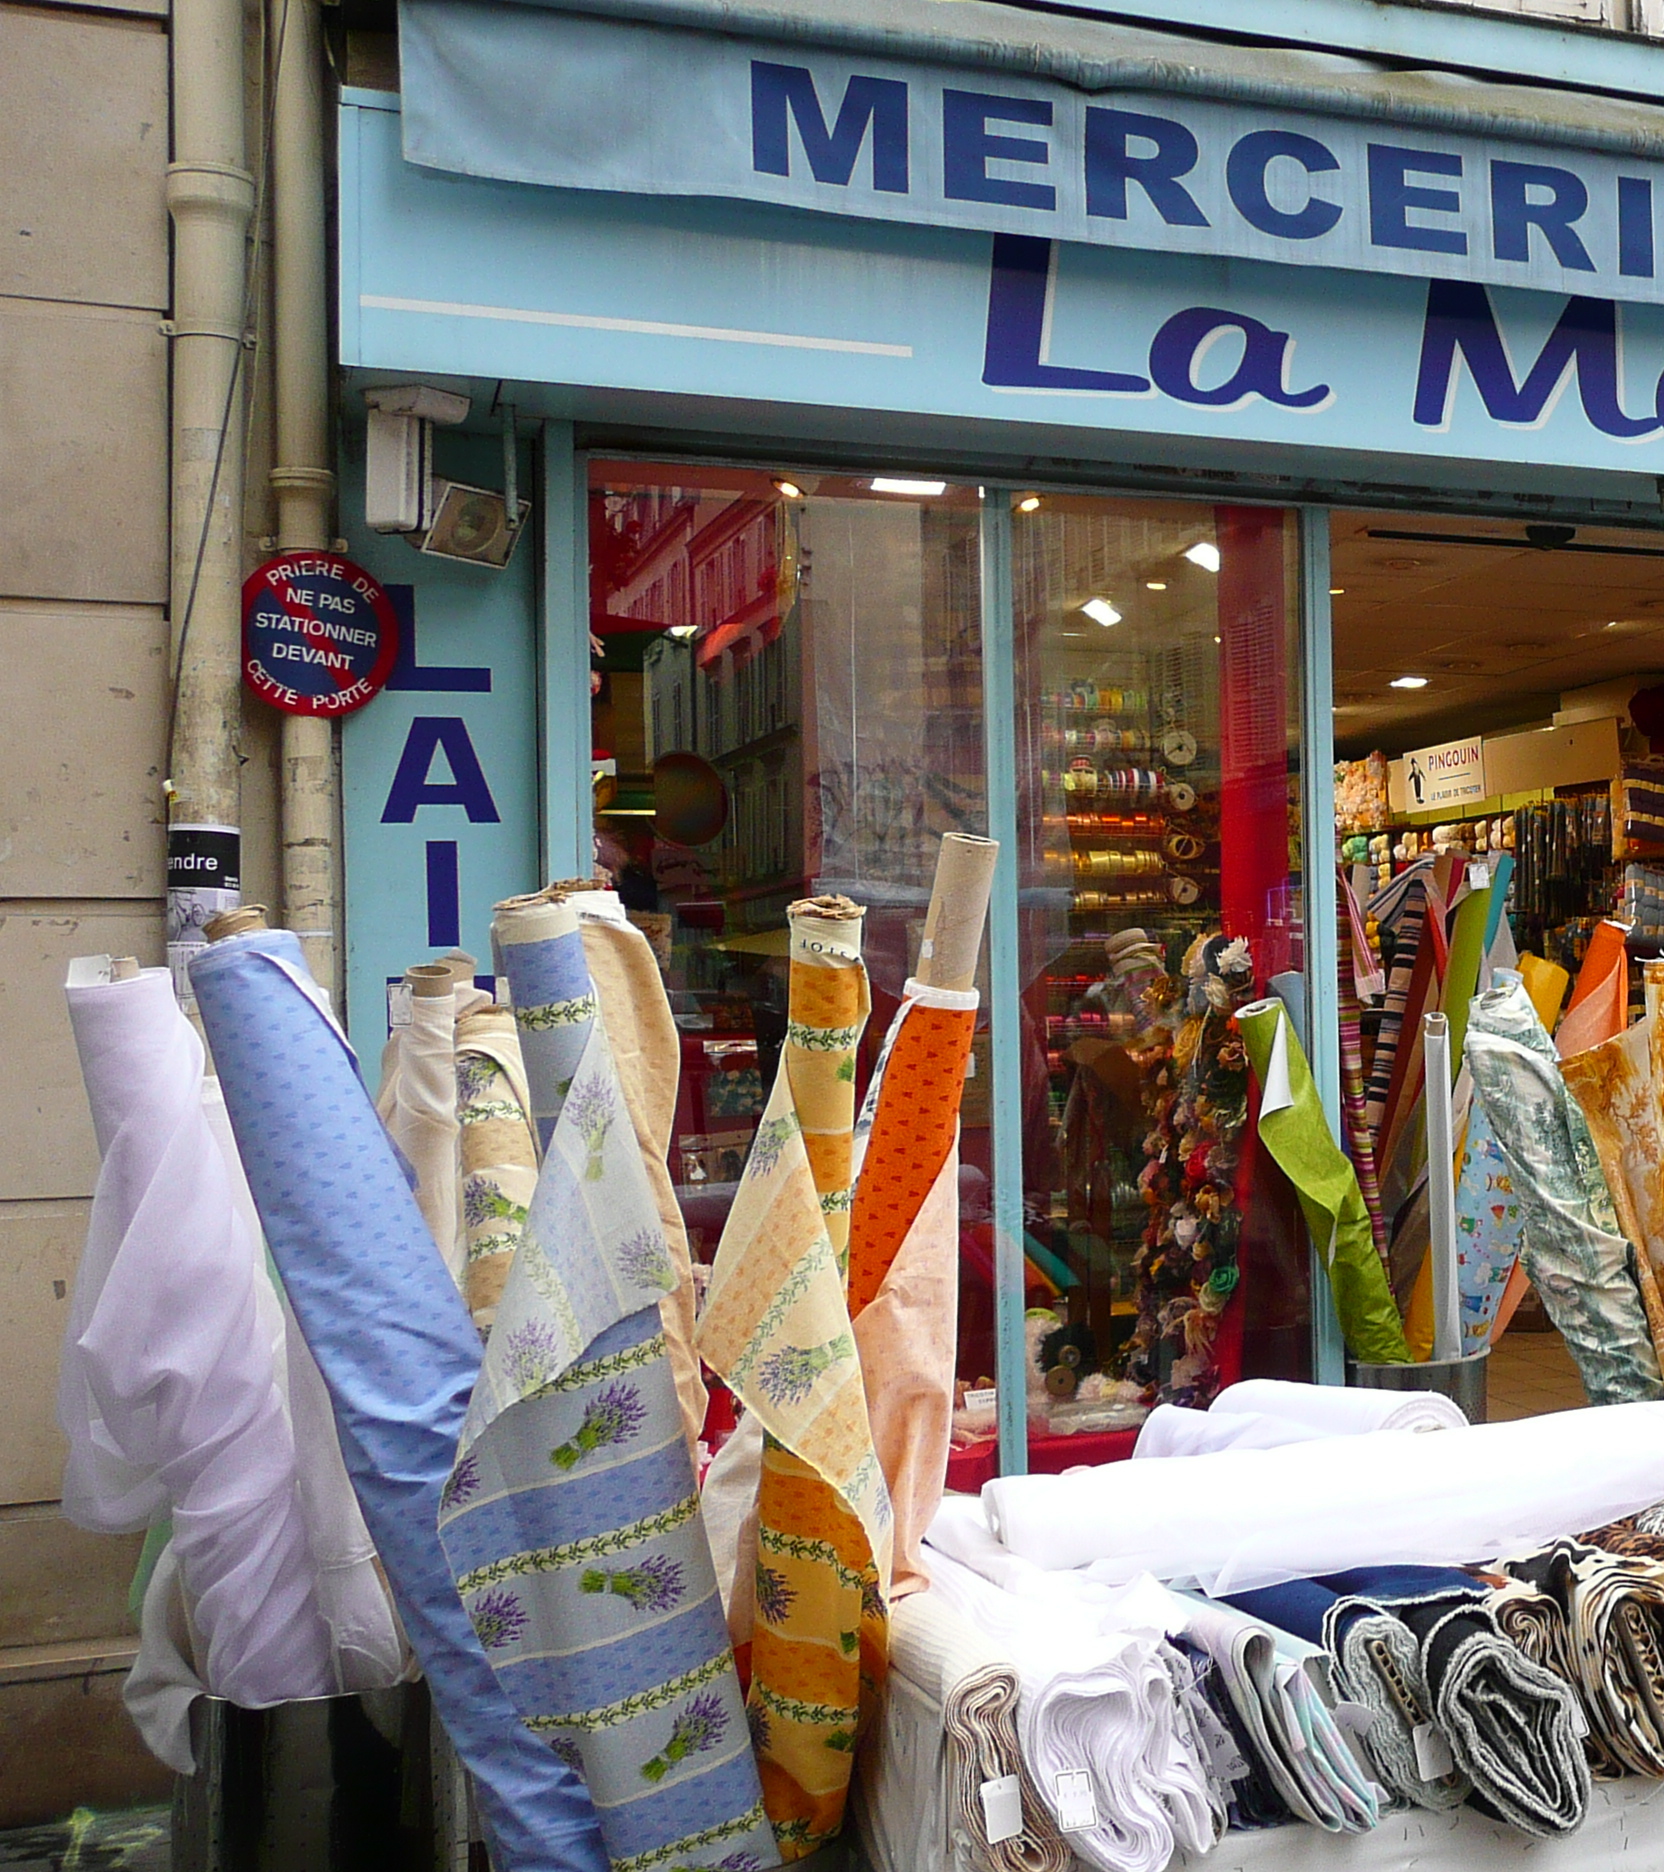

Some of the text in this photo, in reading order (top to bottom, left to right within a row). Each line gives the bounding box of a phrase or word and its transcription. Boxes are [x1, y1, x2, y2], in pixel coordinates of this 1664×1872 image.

[981, 232, 1333, 410] La
[265, 560, 379, 603] PRIERE DE
[286, 587, 355, 614] NE PAS
[255, 612, 377, 648] STATIONNER
[272, 643, 354, 670] DEVANT
[247, 659, 373, 709] CETTE PORTE
[1428, 745, 1479, 771] PINGOUIN
[381, 584, 500, 1040] LAI
